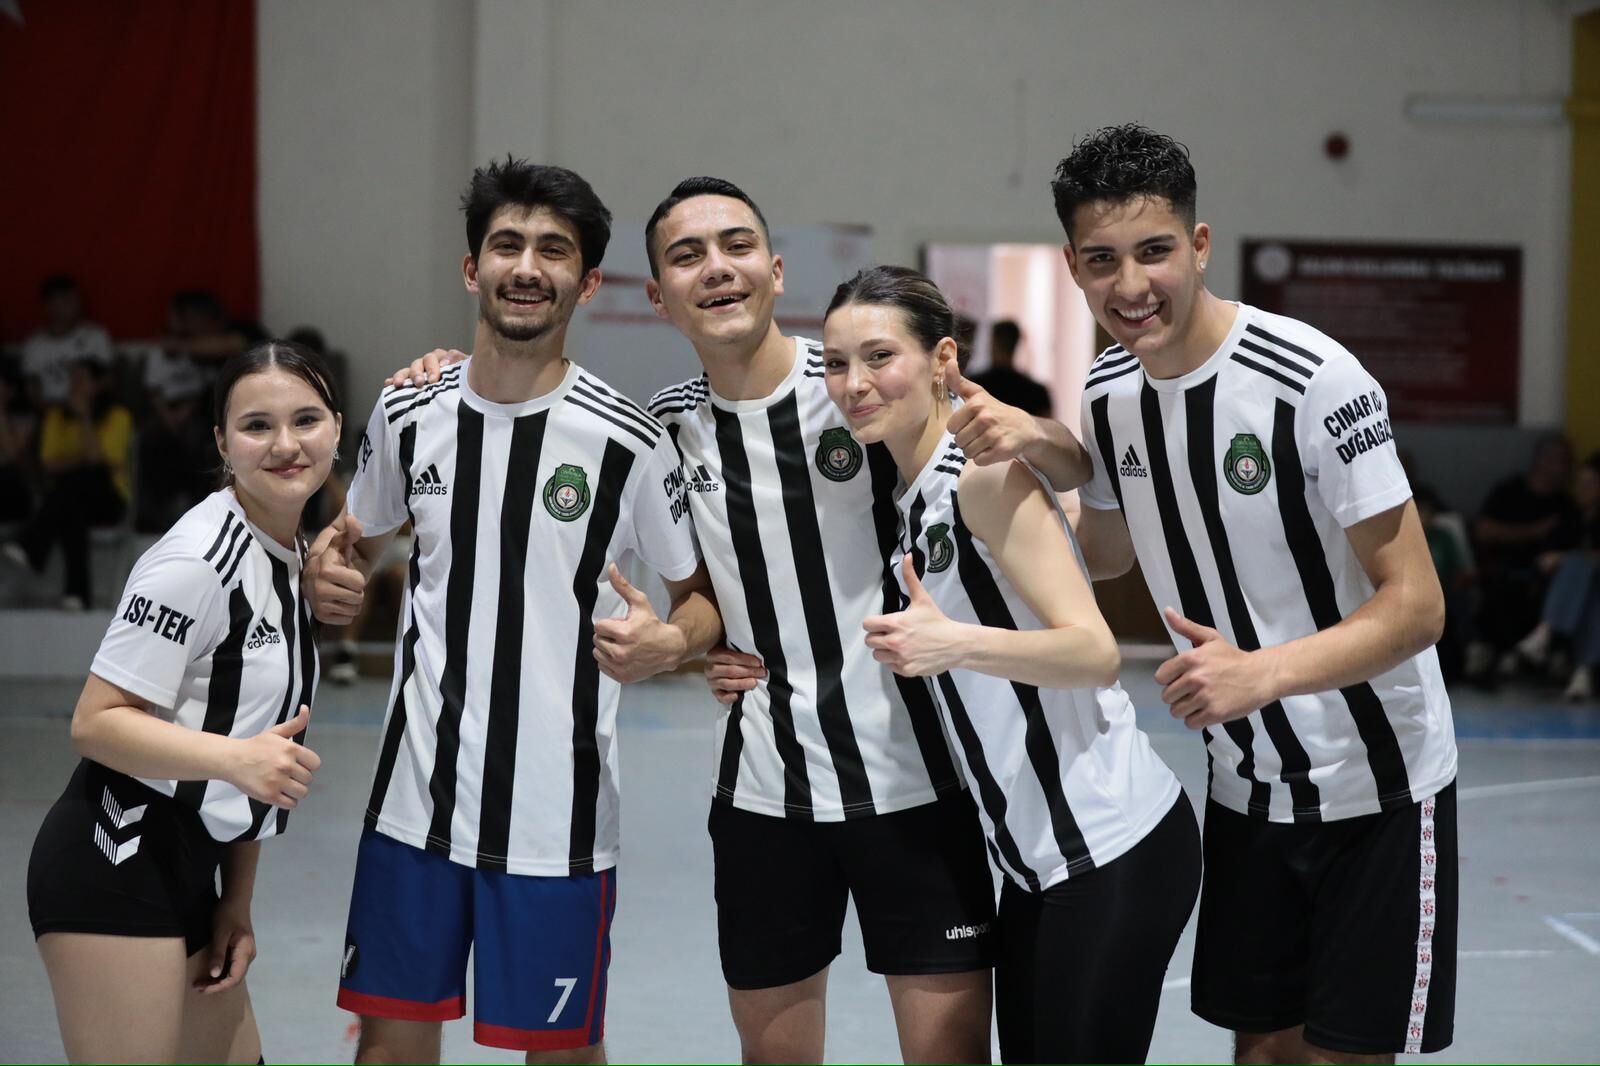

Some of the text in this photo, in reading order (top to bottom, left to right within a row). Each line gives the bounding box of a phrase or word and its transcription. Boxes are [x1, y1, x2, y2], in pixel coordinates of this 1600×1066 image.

[1324, 394, 1374, 439] ÇINAR
[1120, 465, 1147, 478] adidas
[411, 483, 448, 496] adidas
[123, 594, 195, 646] ISI-TEK
[248, 633, 281, 650] adidas
[547, 977, 578, 1023] 7
